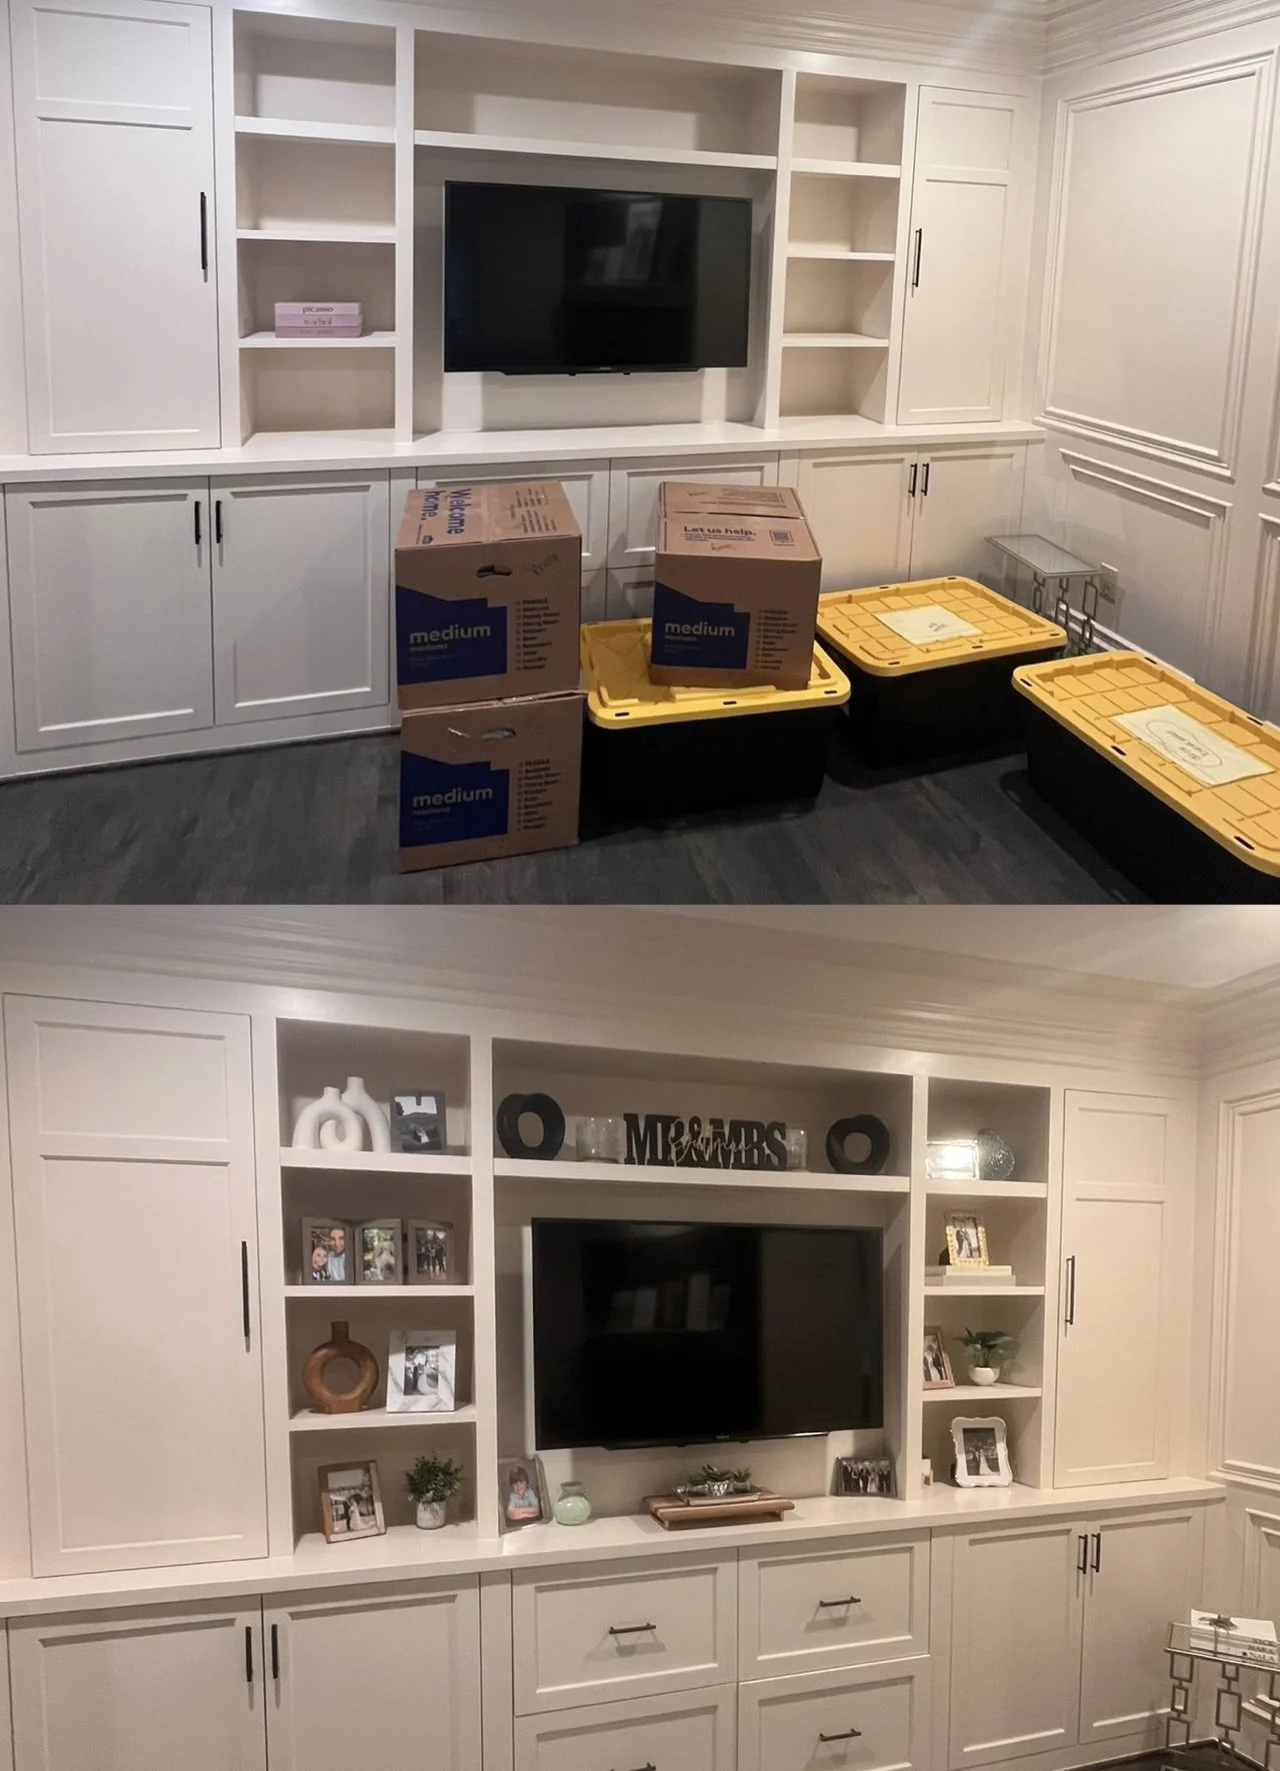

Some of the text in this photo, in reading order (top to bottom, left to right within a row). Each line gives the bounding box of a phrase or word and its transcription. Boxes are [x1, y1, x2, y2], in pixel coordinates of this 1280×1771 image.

[420, 490, 447, 521] home.
[447, 488, 472, 535] Welcome
[683, 525, 705, 533] Let
[724, 527, 757, 536] help.
[409, 623, 491, 645] medium
[664, 620, 736, 637] medium
[412, 787, 493, 808] medium
